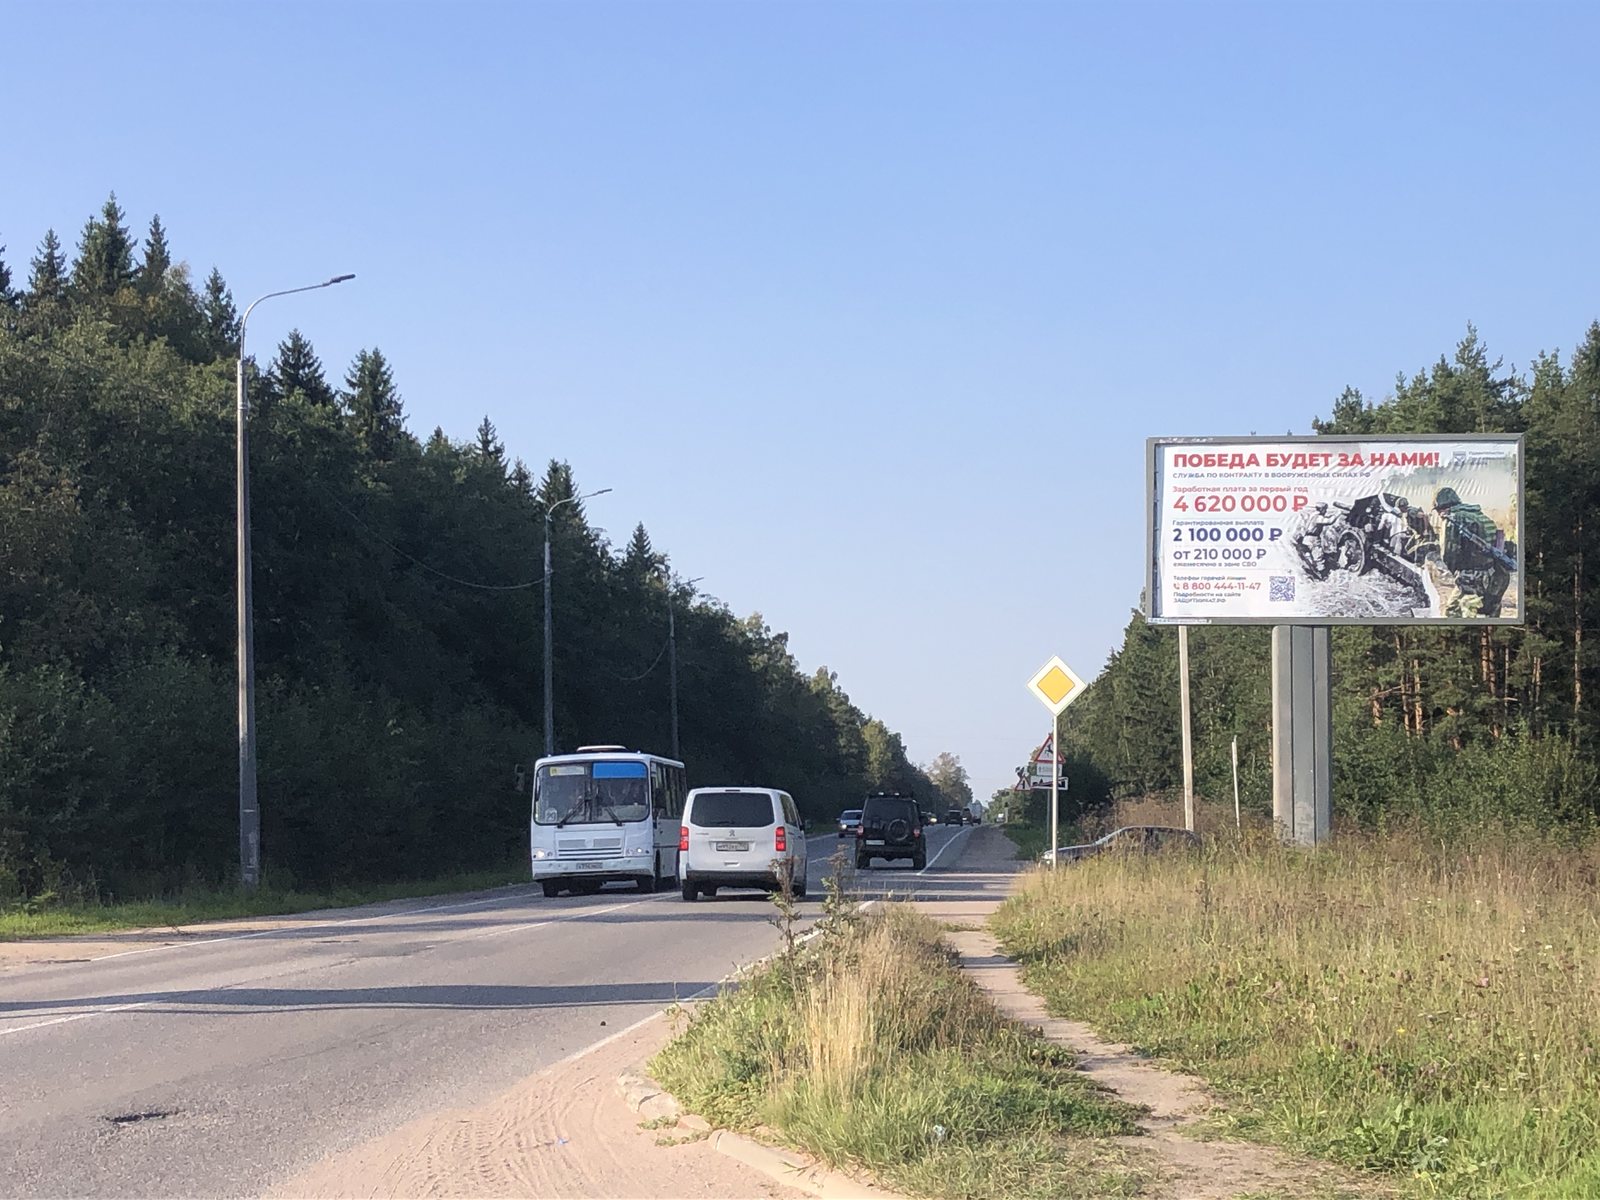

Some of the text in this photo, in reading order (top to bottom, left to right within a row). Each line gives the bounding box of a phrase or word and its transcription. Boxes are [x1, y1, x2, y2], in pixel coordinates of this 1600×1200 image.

[1173, 452, 1440, 470] ПОБЕДА БУДЕТ ЗА НАМИ!
[1172, 485, 1221, 493] Заработная
[1259, 485, 1292, 493] первый
[1172, 527, 1183, 542] 2
[1188, 527, 1222, 542] 100
[1225, 527, 1264, 542] 000
[1172, 550, 1191, 560] от
[1193, 548, 1219, 560] 210
[1221, 548, 1253, 560] 000
[1182, 582, 1262, 590] 8 800 444-11-47
